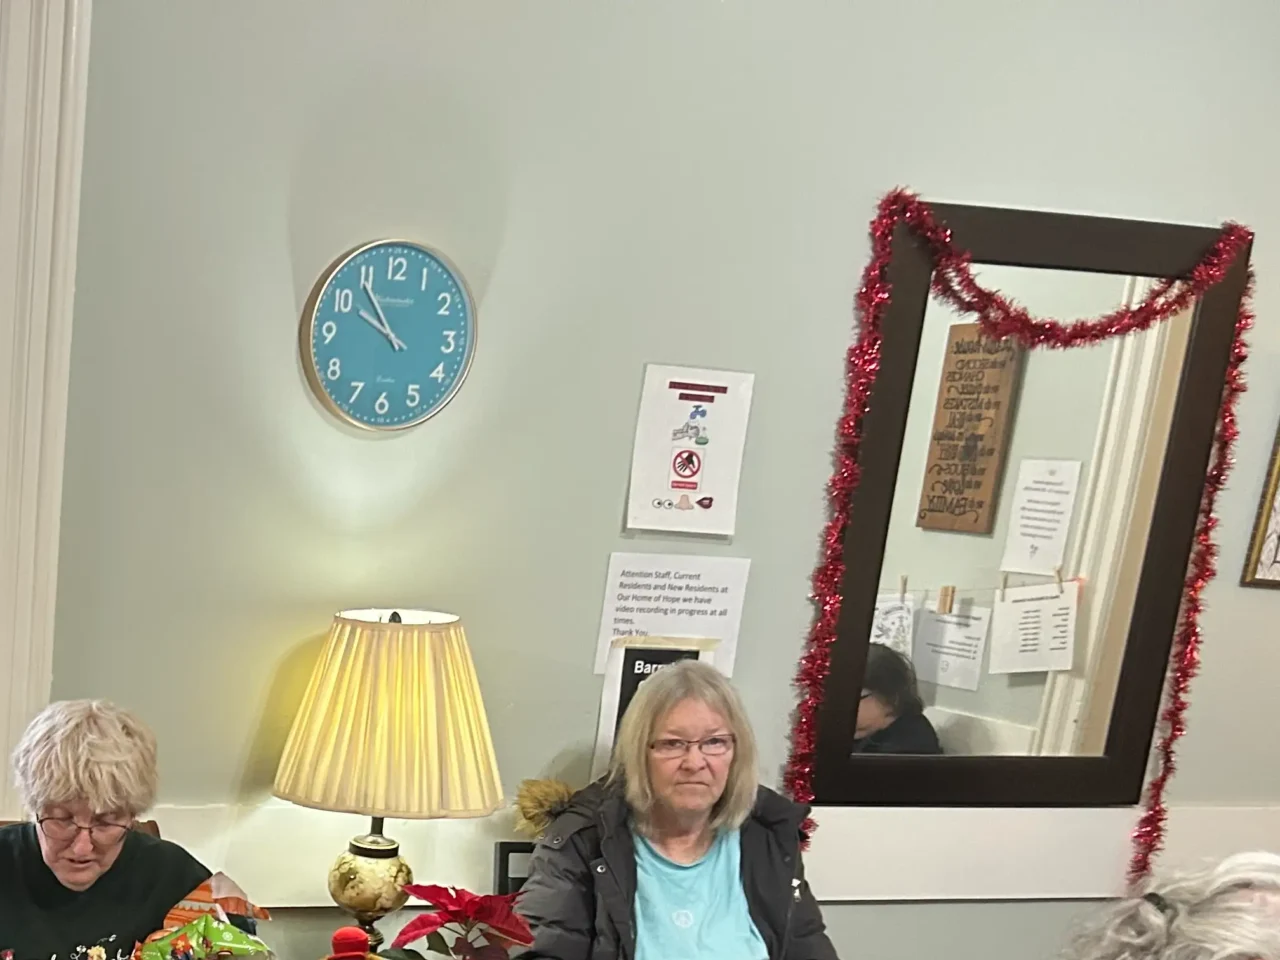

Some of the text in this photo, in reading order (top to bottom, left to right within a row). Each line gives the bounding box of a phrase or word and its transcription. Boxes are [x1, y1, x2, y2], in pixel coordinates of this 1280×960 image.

[387, 256, 408, 281] 12
[421, 267, 427, 291] 1
[334, 288, 352, 313] 10
[437, 292, 451, 315] 2
[322, 321, 336, 345] 9
[440, 330, 456, 353] 3
[327, 358, 341, 380] 8
[429, 362, 445, 384] 4
[349, 381, 365, 404] 7
[374, 392, 389, 414] 6
[406, 384, 420, 407] 5
[620, 570, 701, 580] Attention Staff, Current
[619, 582, 652, 590] Residents
[653, 583, 666, 591] and
[685, 584, 719, 593] Residents
[631, 594, 652, 602] Home
[653, 594, 661, 602] of
[662, 595, 681, 604] Hope
[693, 596, 712, 604] have
[614, 617, 635, 625] times.
[615, 605, 635, 613] video
[636, 606, 668, 615] recording
[677, 608, 708, 616] progress
[612, 628, 633, 636] Thank
[634, 660, 667, 674] Barr
